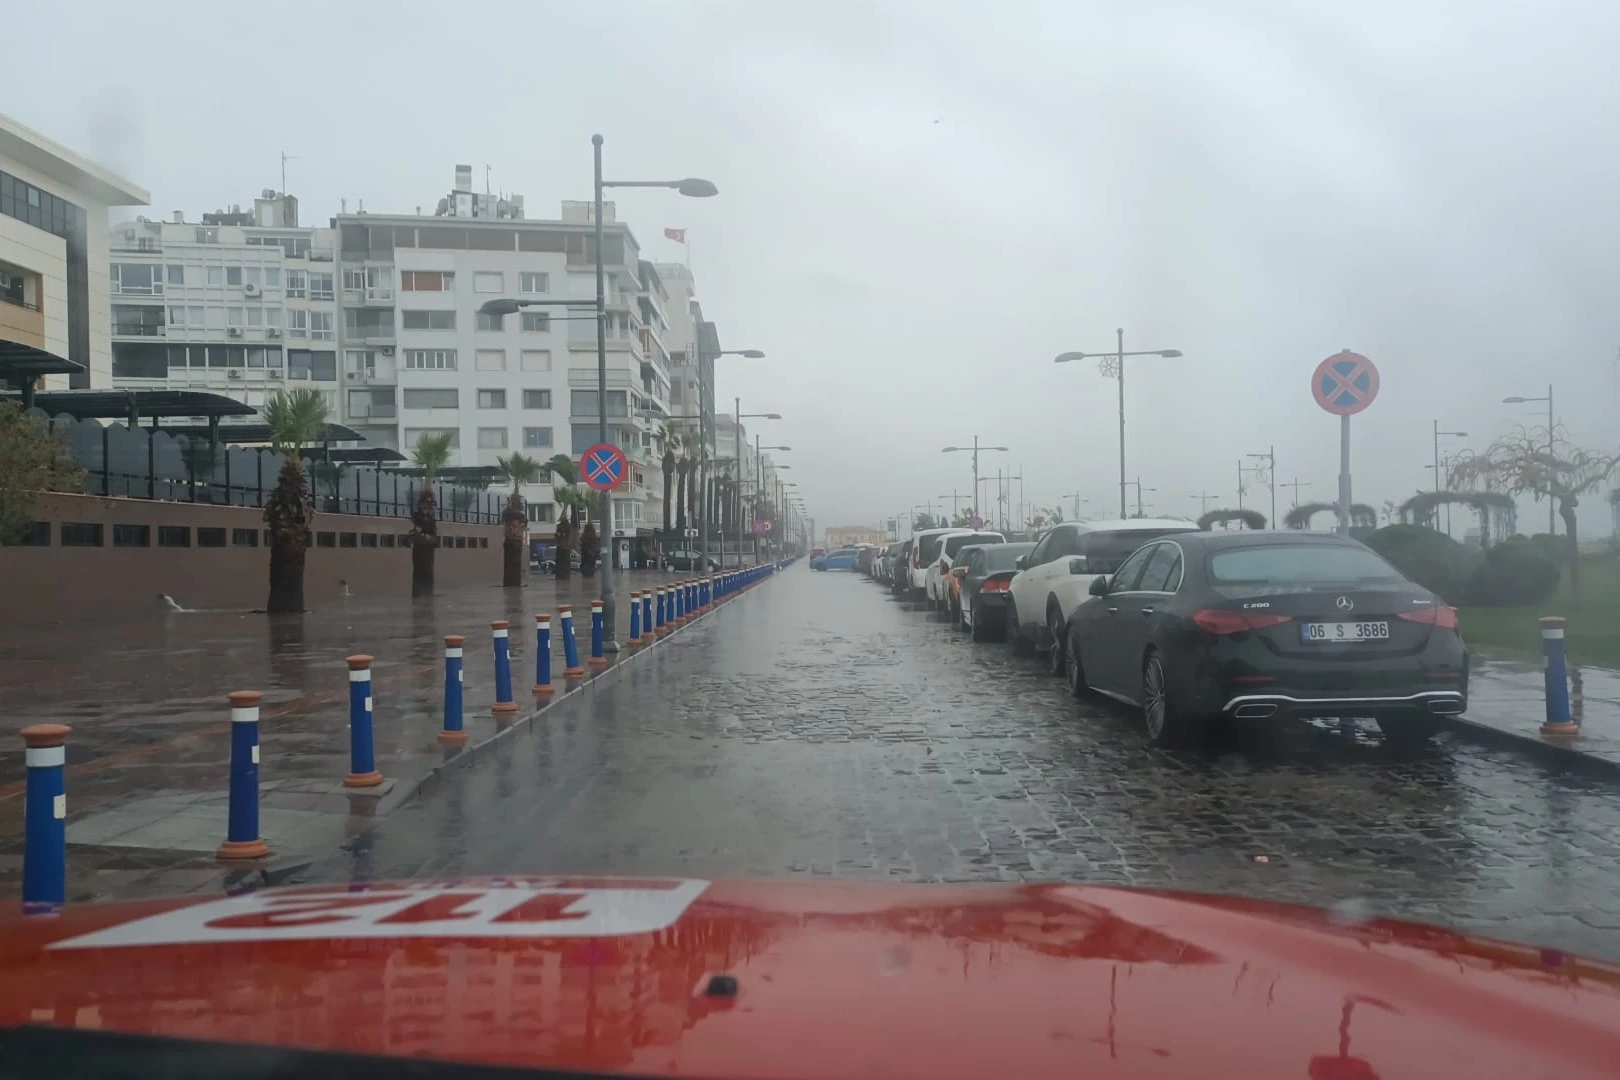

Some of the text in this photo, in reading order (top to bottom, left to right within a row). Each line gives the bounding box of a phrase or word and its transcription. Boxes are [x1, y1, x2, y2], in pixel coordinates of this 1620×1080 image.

[1309, 623, 1388, 638] 06 S 3686
[202, 893, 595, 929] 112
